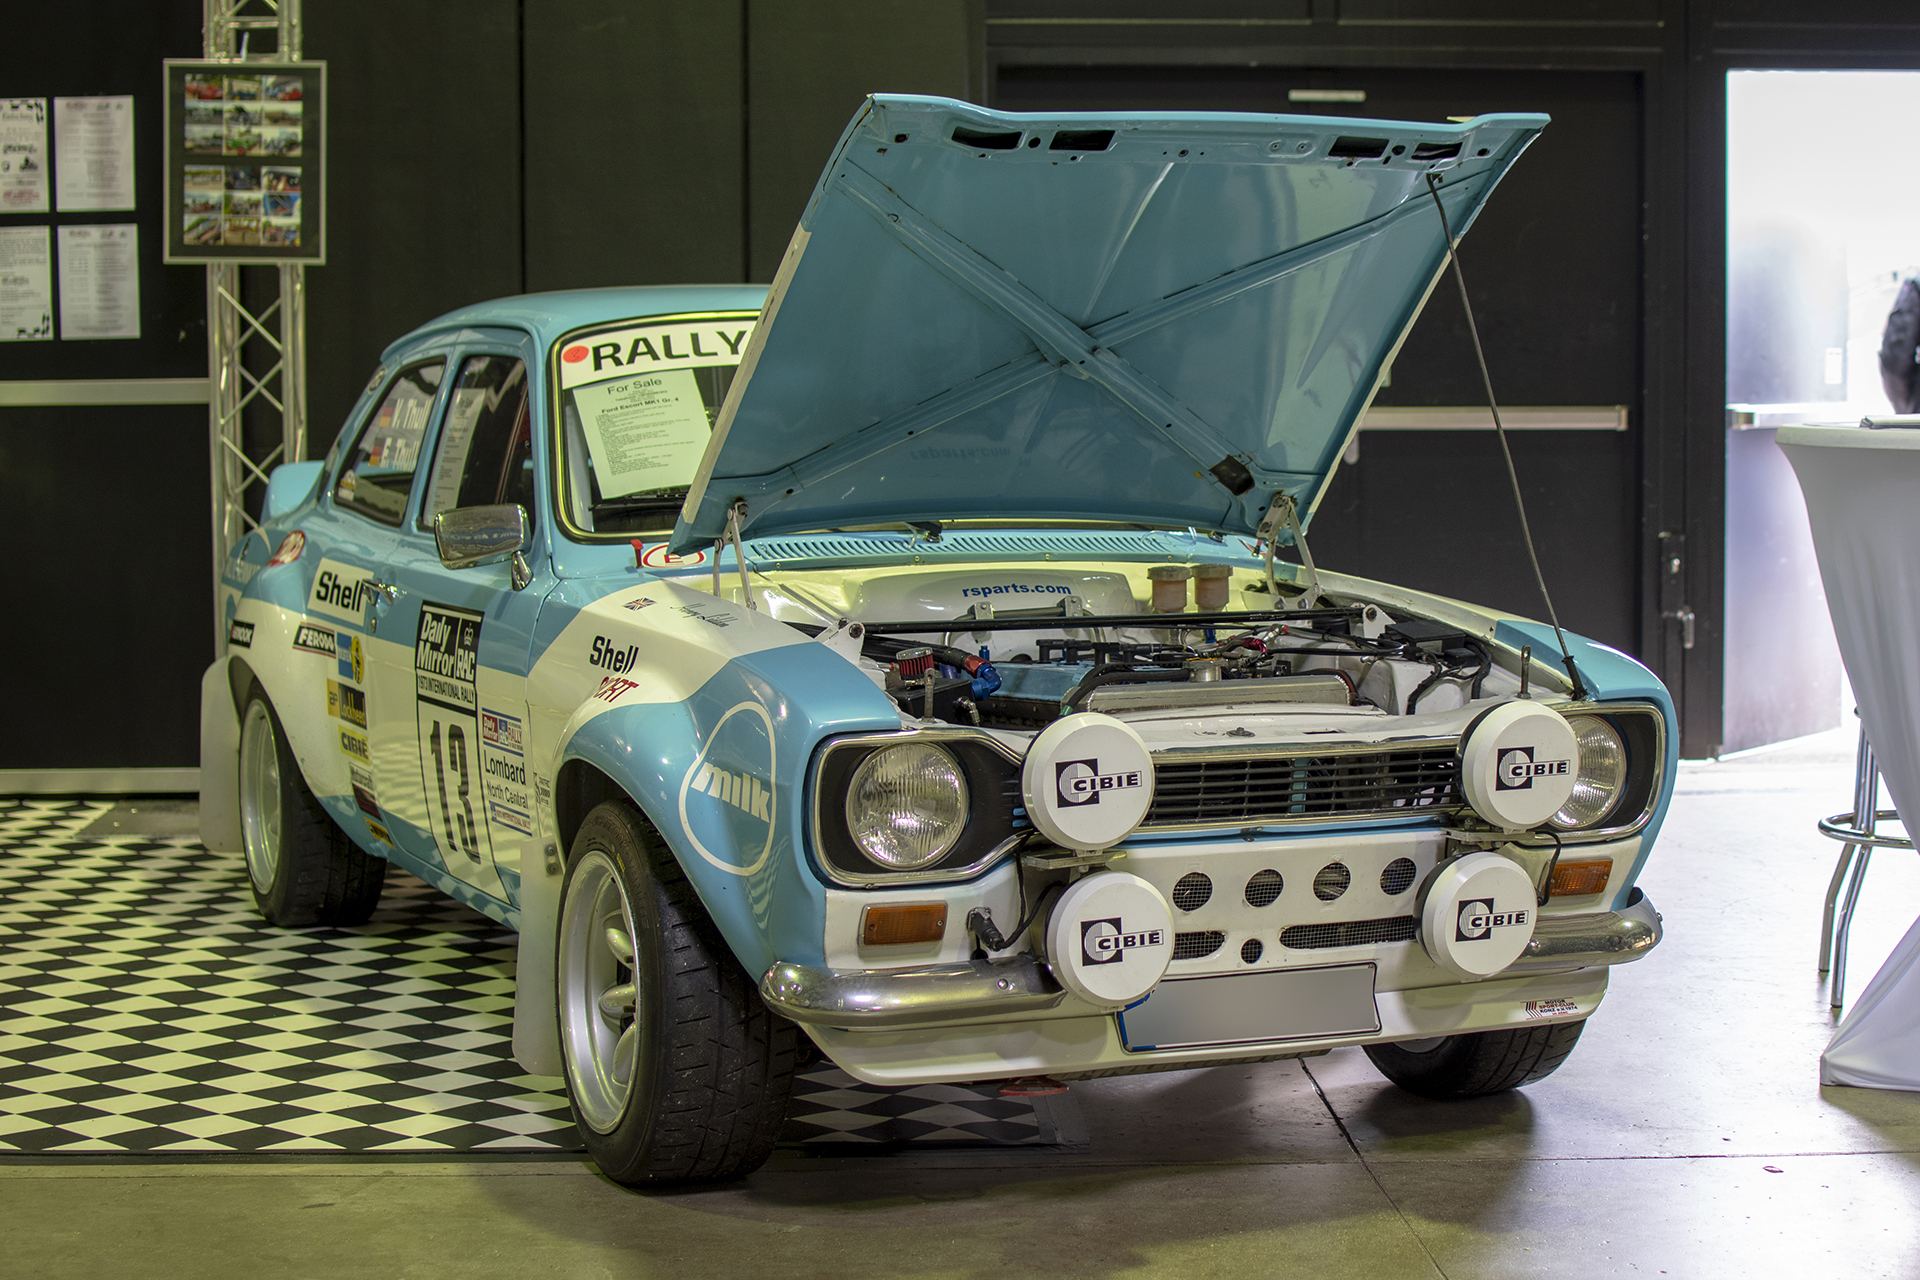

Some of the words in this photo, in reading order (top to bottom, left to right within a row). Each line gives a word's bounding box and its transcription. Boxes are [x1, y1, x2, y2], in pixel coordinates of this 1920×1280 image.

[607, 384, 629, 395] For
[633, 378, 662, 389] Sale
[620, 402, 643, 410] Escort
[316, 570, 364, 612] Shell
[962, 583, 1072, 598] rsparts.com
[420, 612, 452, 653] Daily
[416, 640, 455, 677] Mirror
[456, 648, 475, 681] RAC
[589, 635, 640, 675] Shell
[427, 676, 460, 700] INTERNATIONAL
[460, 685, 475, 704] RALLY
[484, 749, 527, 786] Lombard
[429, 720, 482, 865] 13
[486, 779, 505, 801] North
[504, 786, 529, 809] Central
[690, 761, 771, 823] milk
